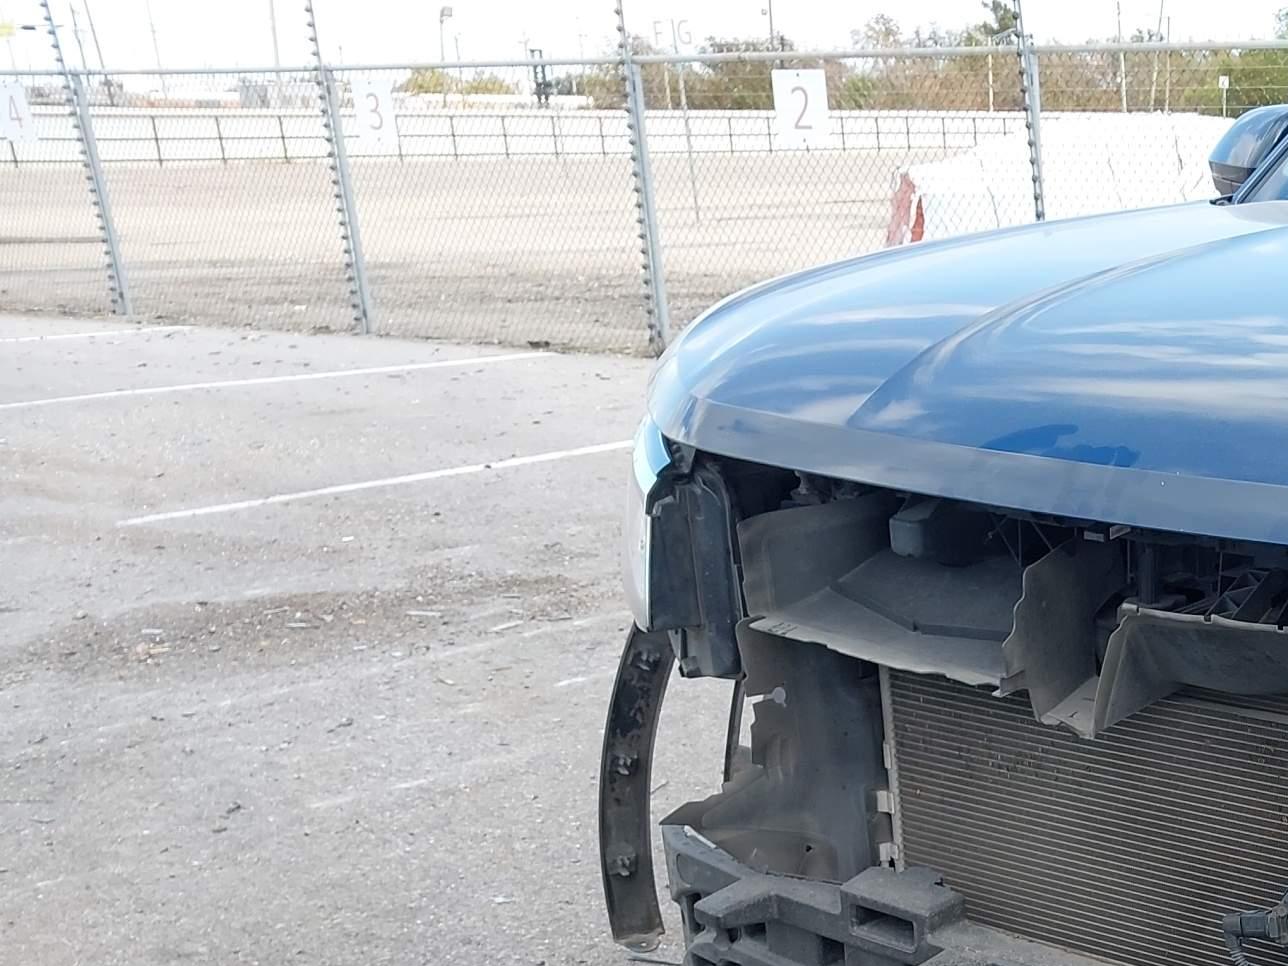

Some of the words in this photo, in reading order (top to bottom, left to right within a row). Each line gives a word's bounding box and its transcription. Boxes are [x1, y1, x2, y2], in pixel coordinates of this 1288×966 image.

[6, 95, 24, 129] 4
[365, 91, 384, 131] 3
[790, 86, 813, 130] 2
